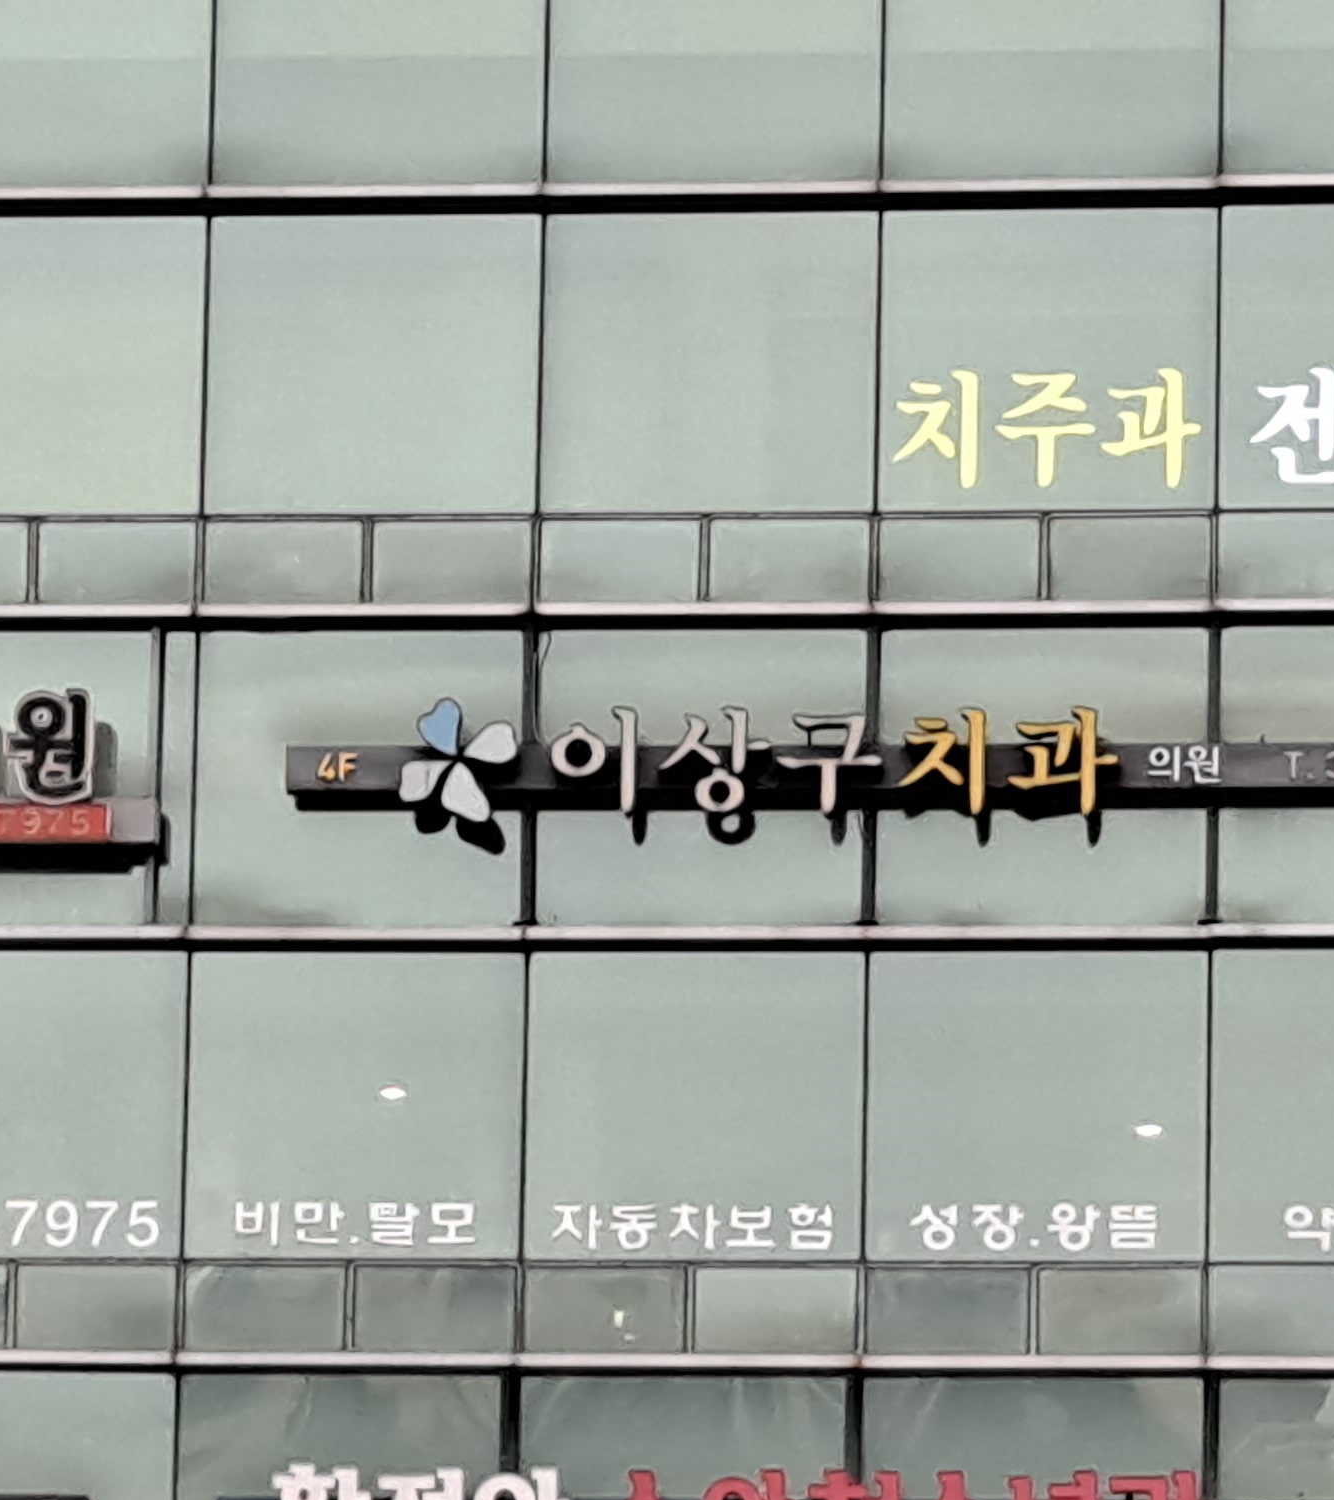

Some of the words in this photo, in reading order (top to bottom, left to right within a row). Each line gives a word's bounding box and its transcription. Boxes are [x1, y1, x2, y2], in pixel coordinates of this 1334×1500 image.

[891, 366, 1202, 490] 치주과
[1147, 745, 1222, 784] 의원
[552, 1202, 835, 1250] 자동차보험
